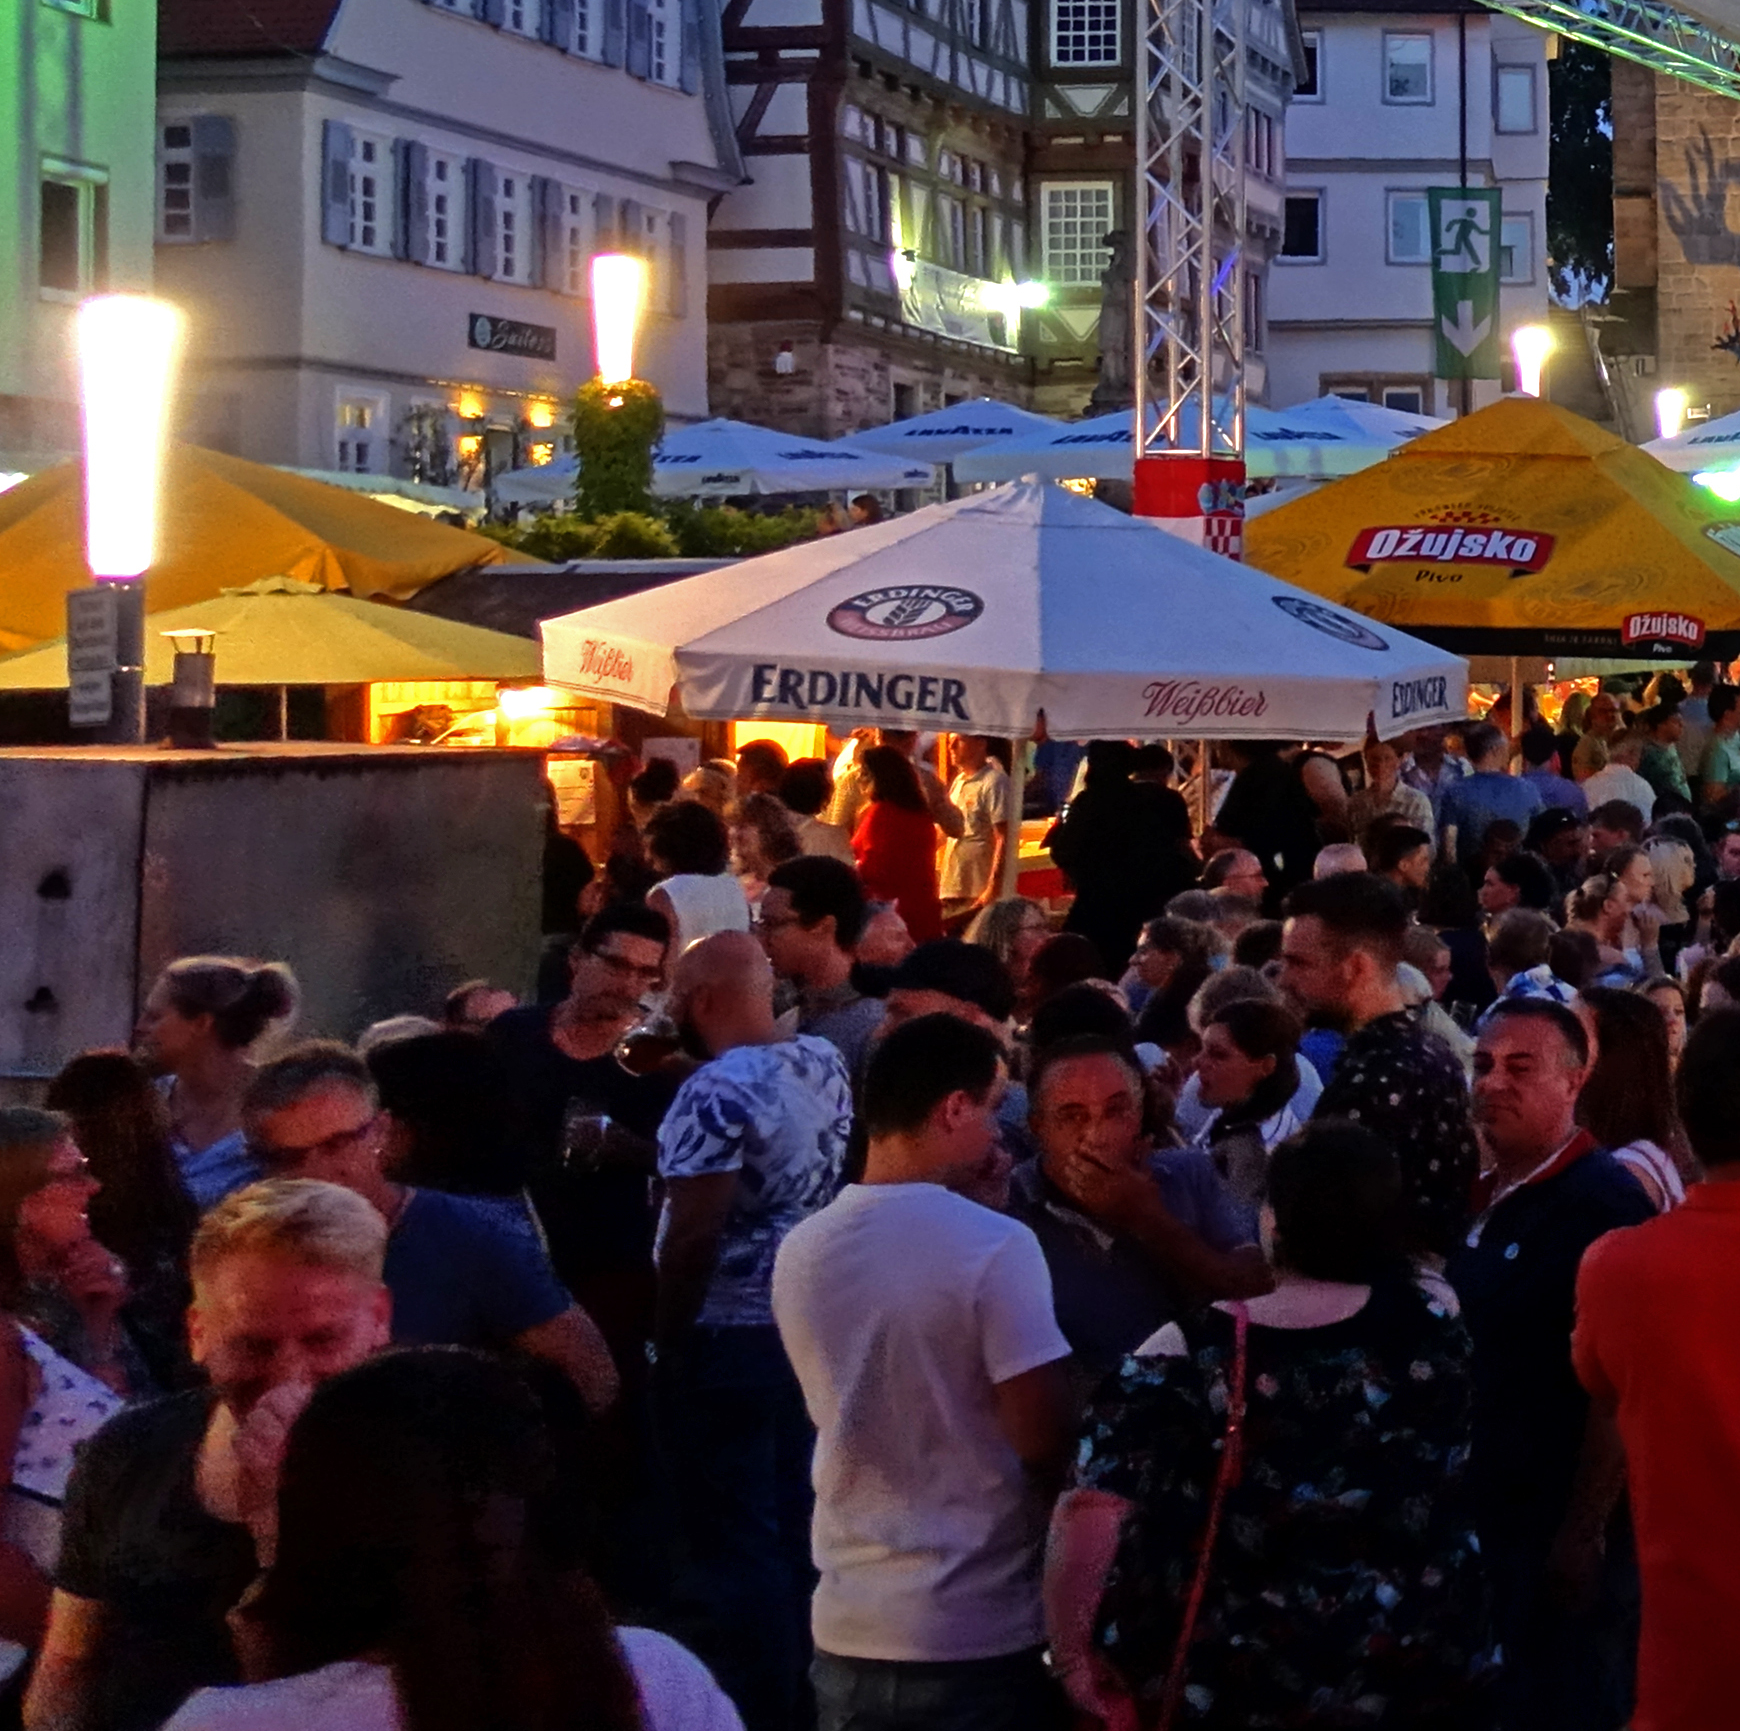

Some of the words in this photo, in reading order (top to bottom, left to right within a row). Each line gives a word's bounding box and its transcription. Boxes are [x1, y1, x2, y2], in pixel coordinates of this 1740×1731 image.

[1366, 528, 1538, 562] Ožujsko
[1414, 570, 1464, 582] Pivo
[853, 588, 976, 612] ERDINGER
[1629, 613, 1699, 640] Ožujsko
[1652, 642, 1673, 654] Pivo
[751, 663, 970, 721] ERDINGER
[1142, 680, 1269, 725] Weißbier
